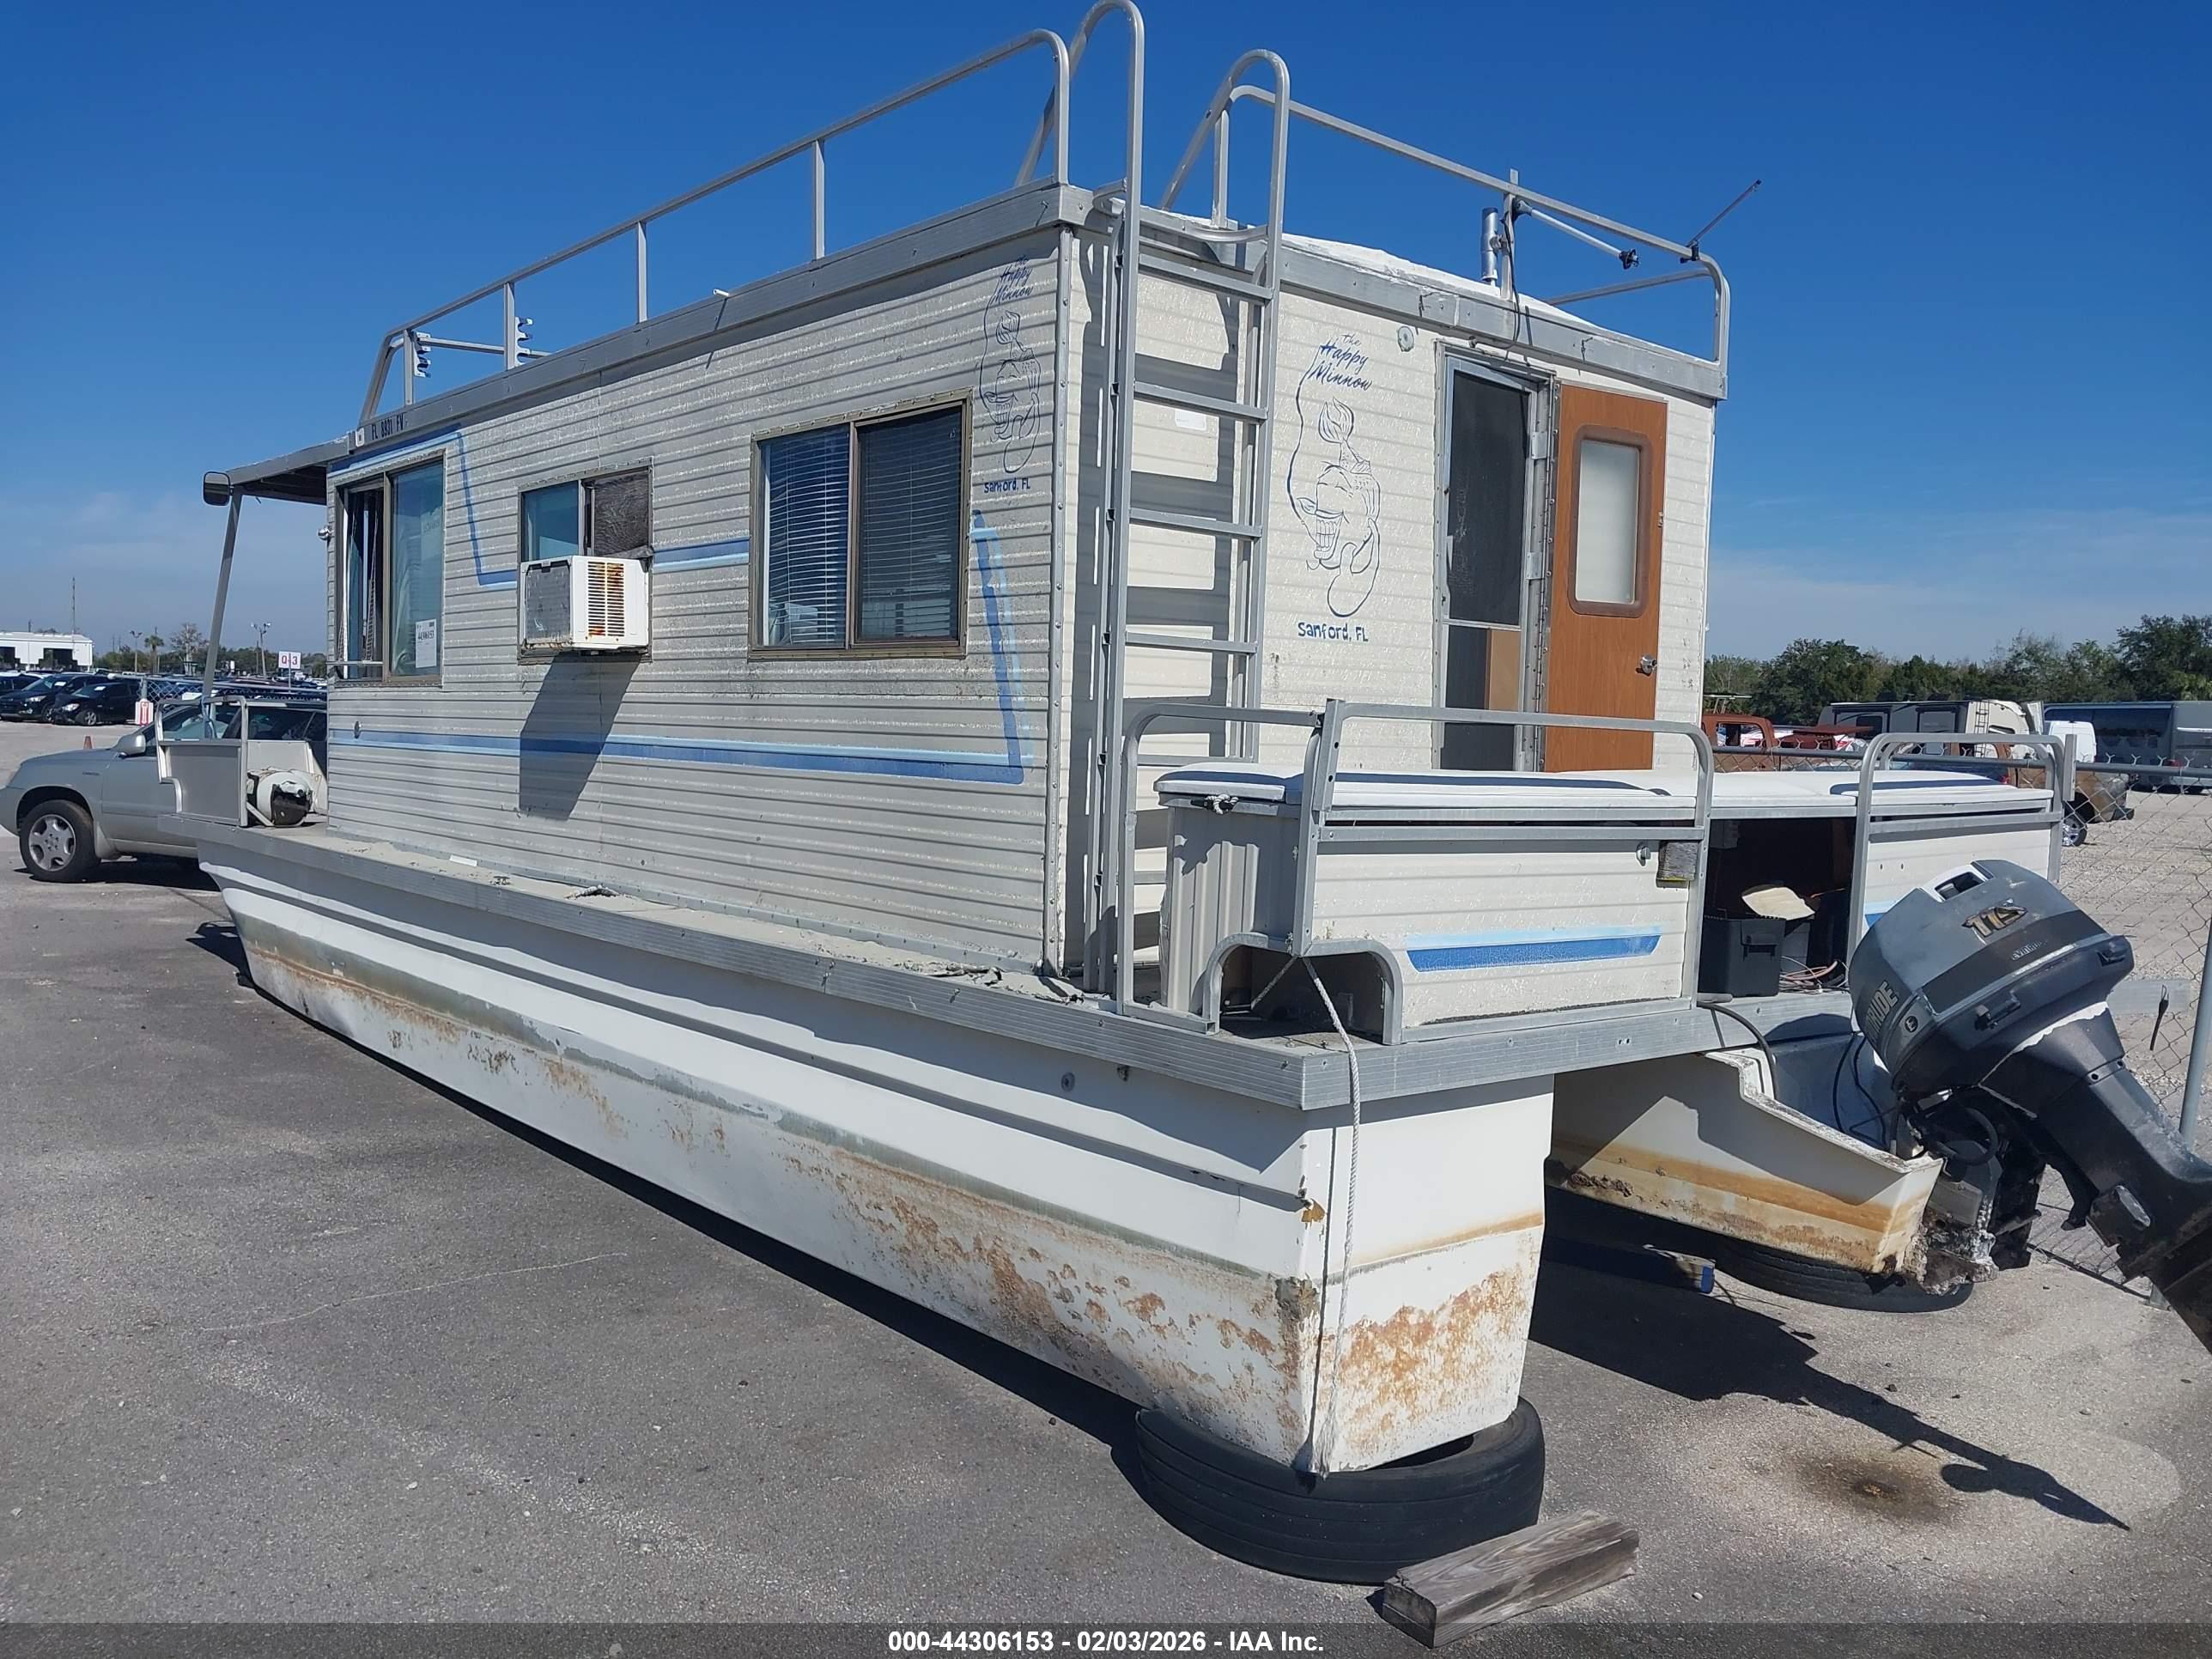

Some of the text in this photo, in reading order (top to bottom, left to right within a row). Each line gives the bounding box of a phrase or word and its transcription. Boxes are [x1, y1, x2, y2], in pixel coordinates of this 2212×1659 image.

[1000, 264, 1033, 287] Happy
[989, 284, 1034, 305] Minnow
[1340, 333, 1362, 345] the
[1320, 337, 1369, 375] Happy
[1307, 360, 1373, 391] Minnow
[372, 424, 378, 440] FL
[1022, 477, 1030, 489] FL
[1297, 622, 1369, 642] Sanford, FL
